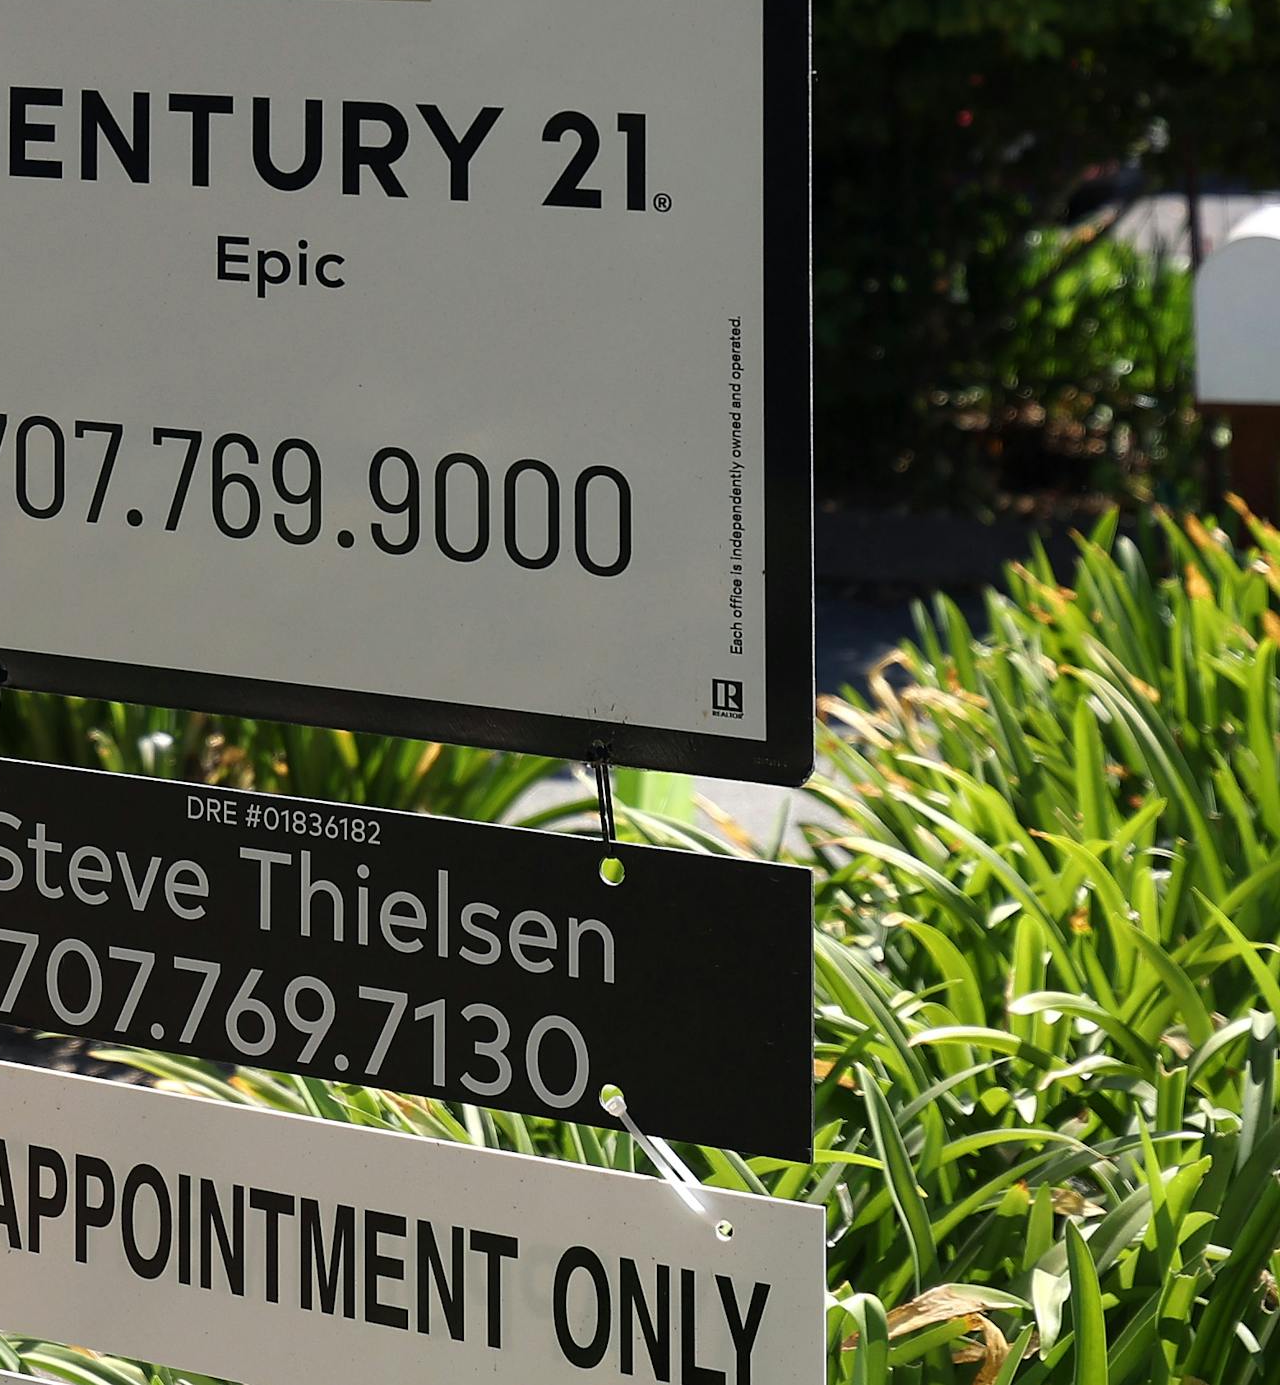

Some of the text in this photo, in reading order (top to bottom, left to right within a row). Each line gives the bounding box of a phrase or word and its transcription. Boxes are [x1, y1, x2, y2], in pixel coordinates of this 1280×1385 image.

[216, 235, 346, 299] Epic
[728, 316, 745, 655] Each office is independently owned and operated.
[187, 795, 381, 845] DRE #01836182
[240, 847, 615, 984] Thielsen
[553, 1245, 771, 1385] ONLY
